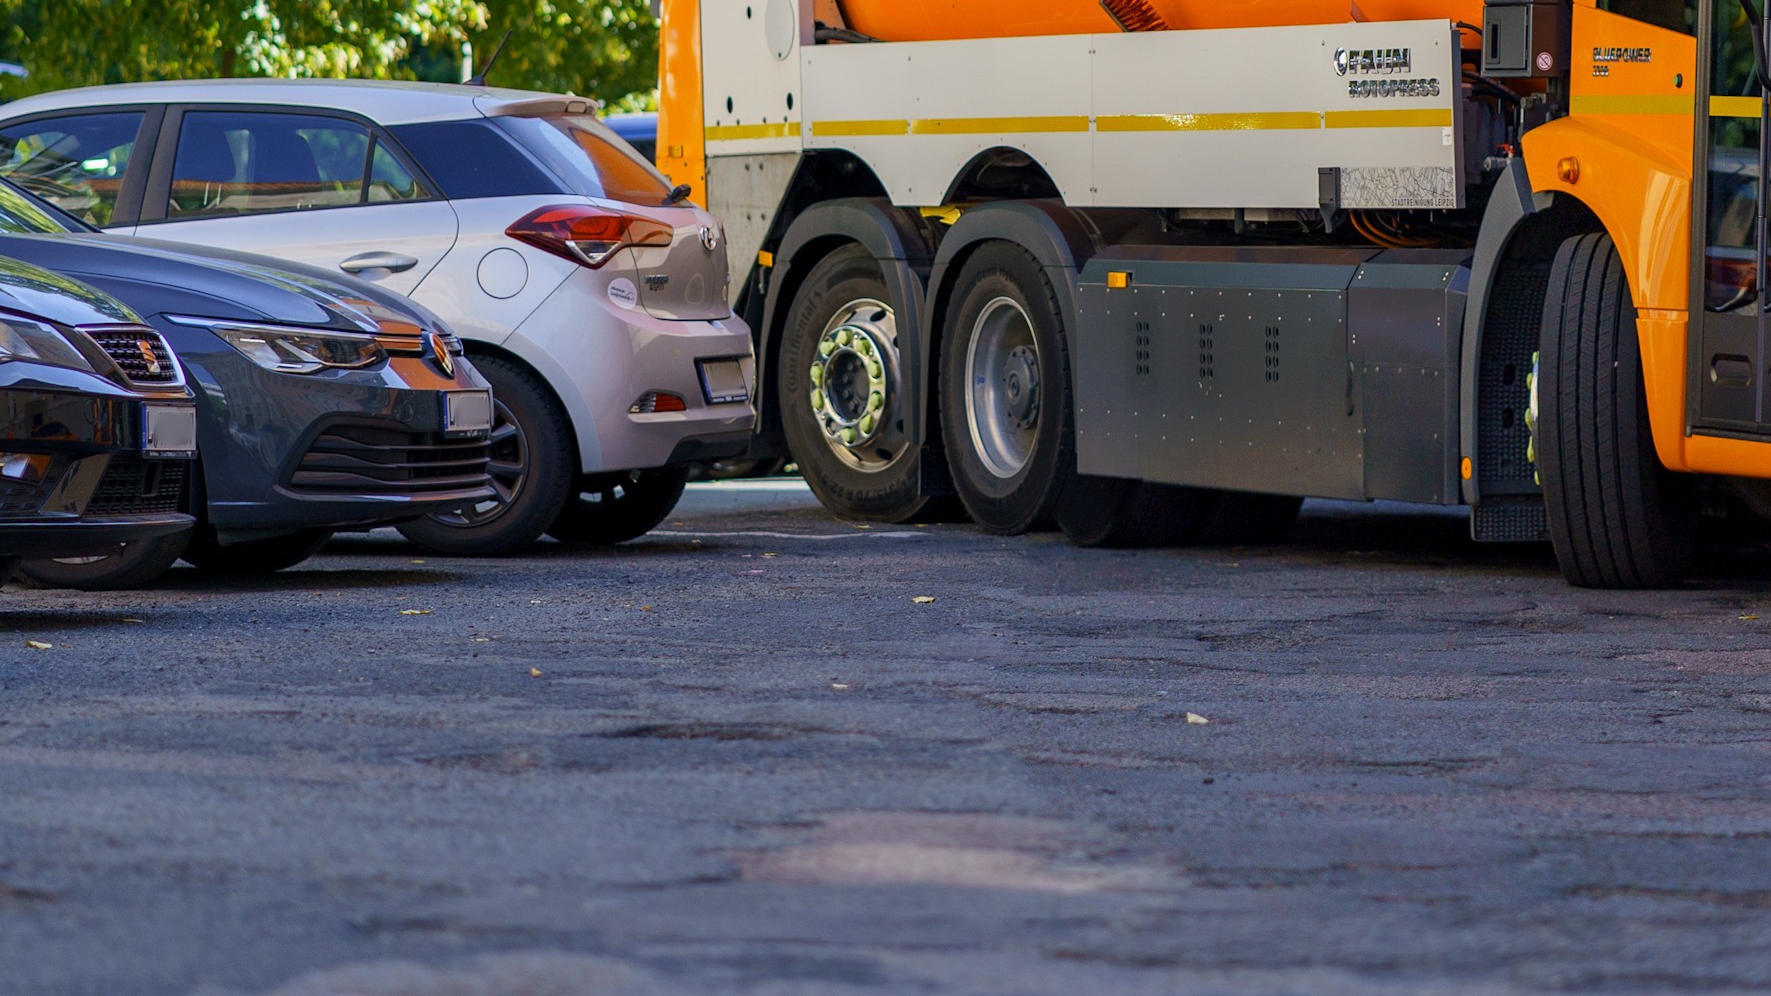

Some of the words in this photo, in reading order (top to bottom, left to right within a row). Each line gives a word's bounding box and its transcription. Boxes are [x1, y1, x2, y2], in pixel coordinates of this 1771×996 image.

[1349, 49, 1411, 74] FAUN
[1593, 47, 1652, 62] BLUEPOWER
[1348, 78, 1440, 98] ROTOPRESS
[1435, 198, 1455, 208] LEIPZIG
